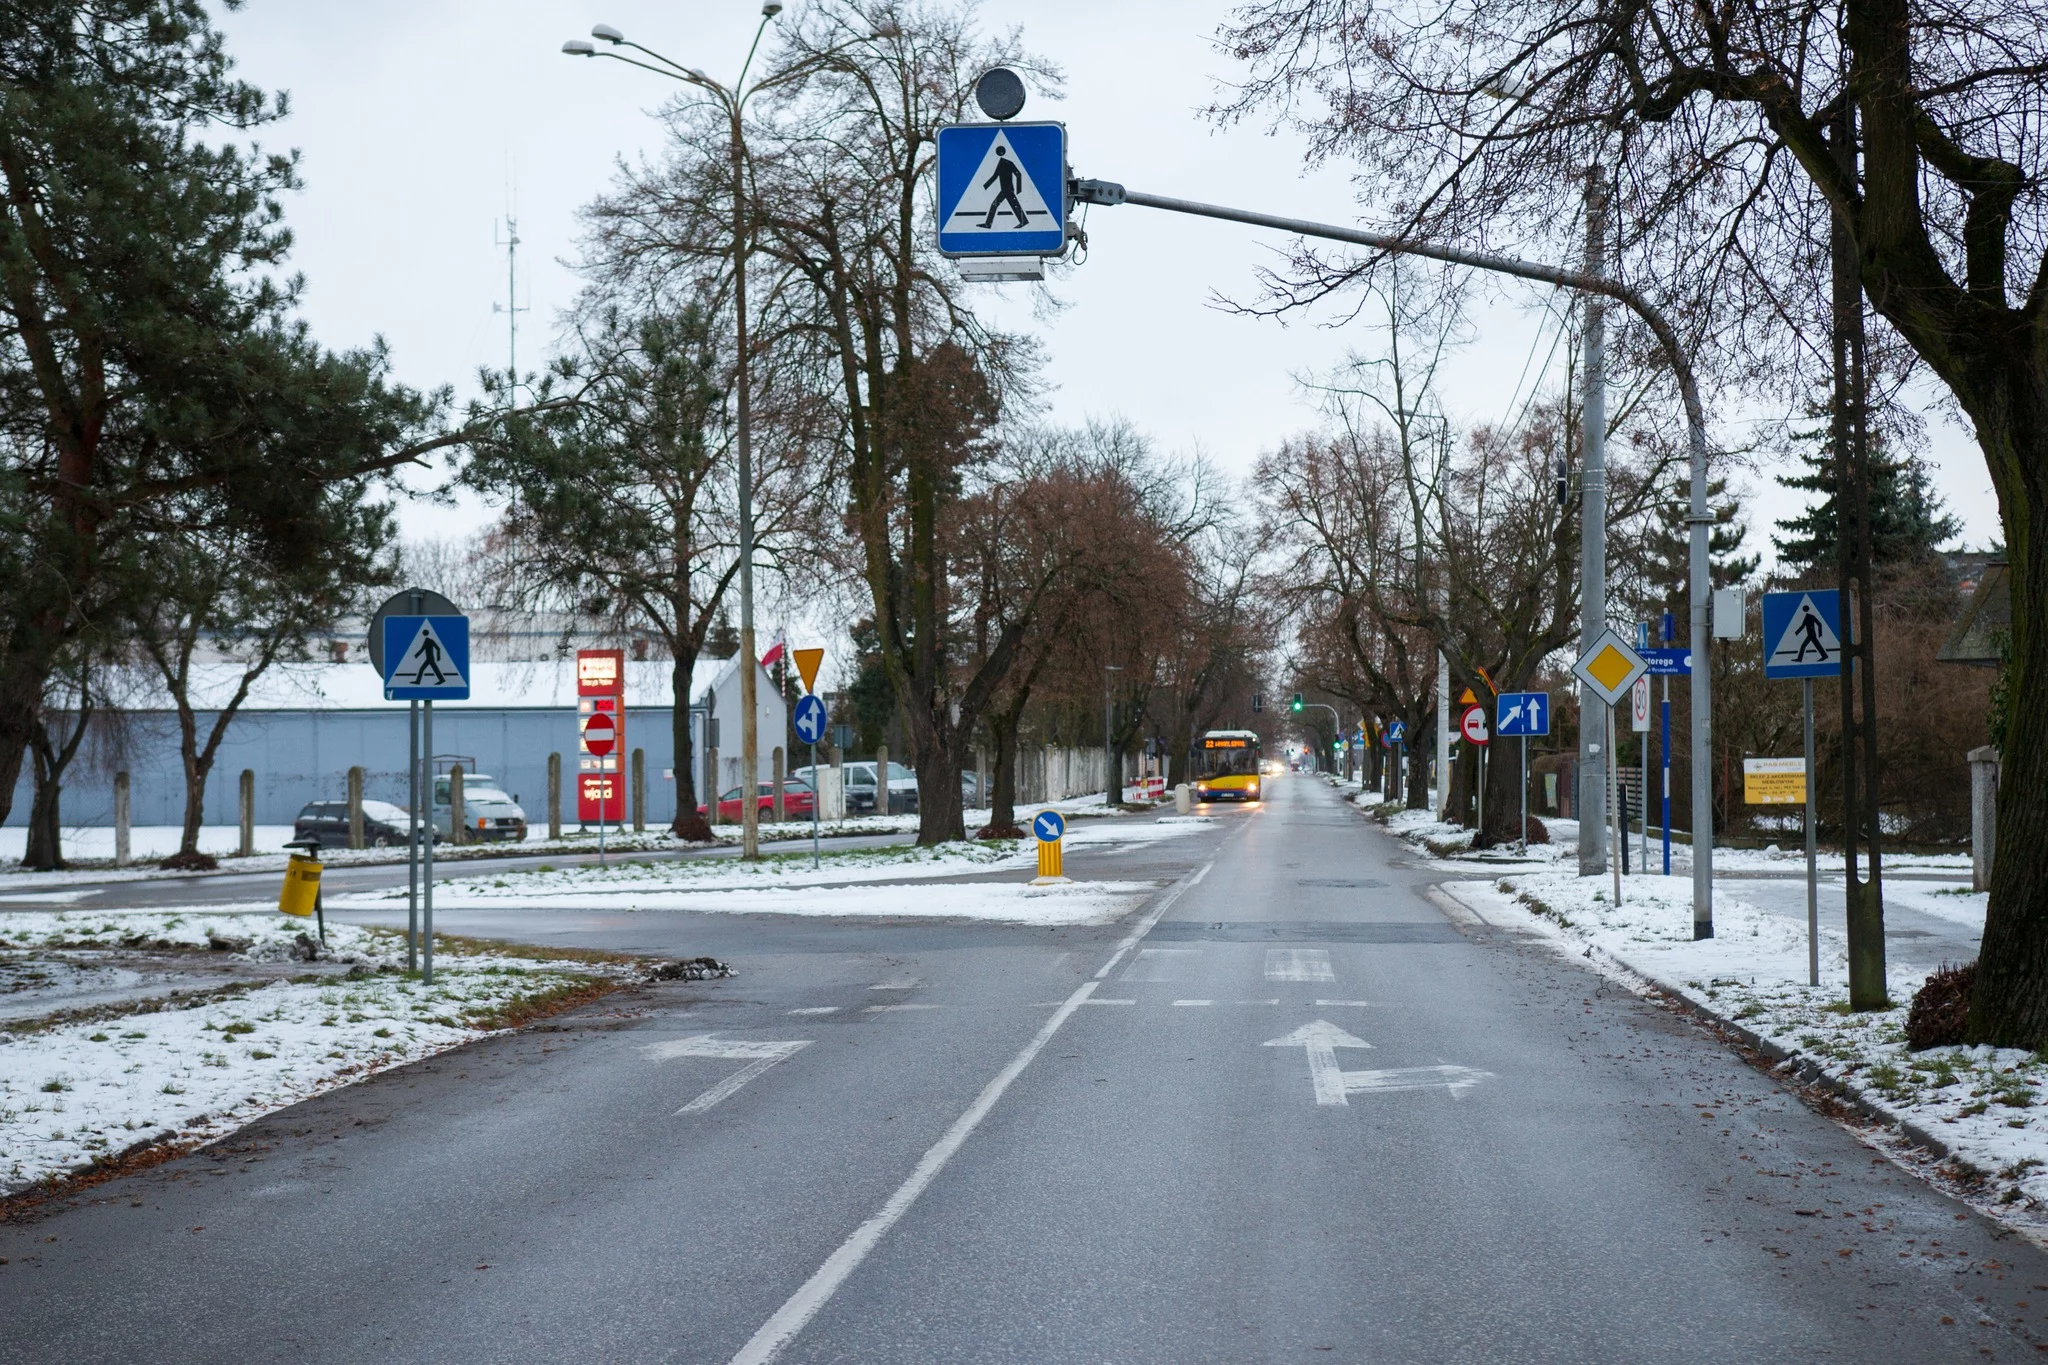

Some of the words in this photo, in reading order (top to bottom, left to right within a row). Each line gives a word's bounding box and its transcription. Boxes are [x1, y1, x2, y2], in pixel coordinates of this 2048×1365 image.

[1645, 657, 1674, 667] torego
[1205, 740, 1214, 748] 22
[584, 786, 612, 801] wjad
